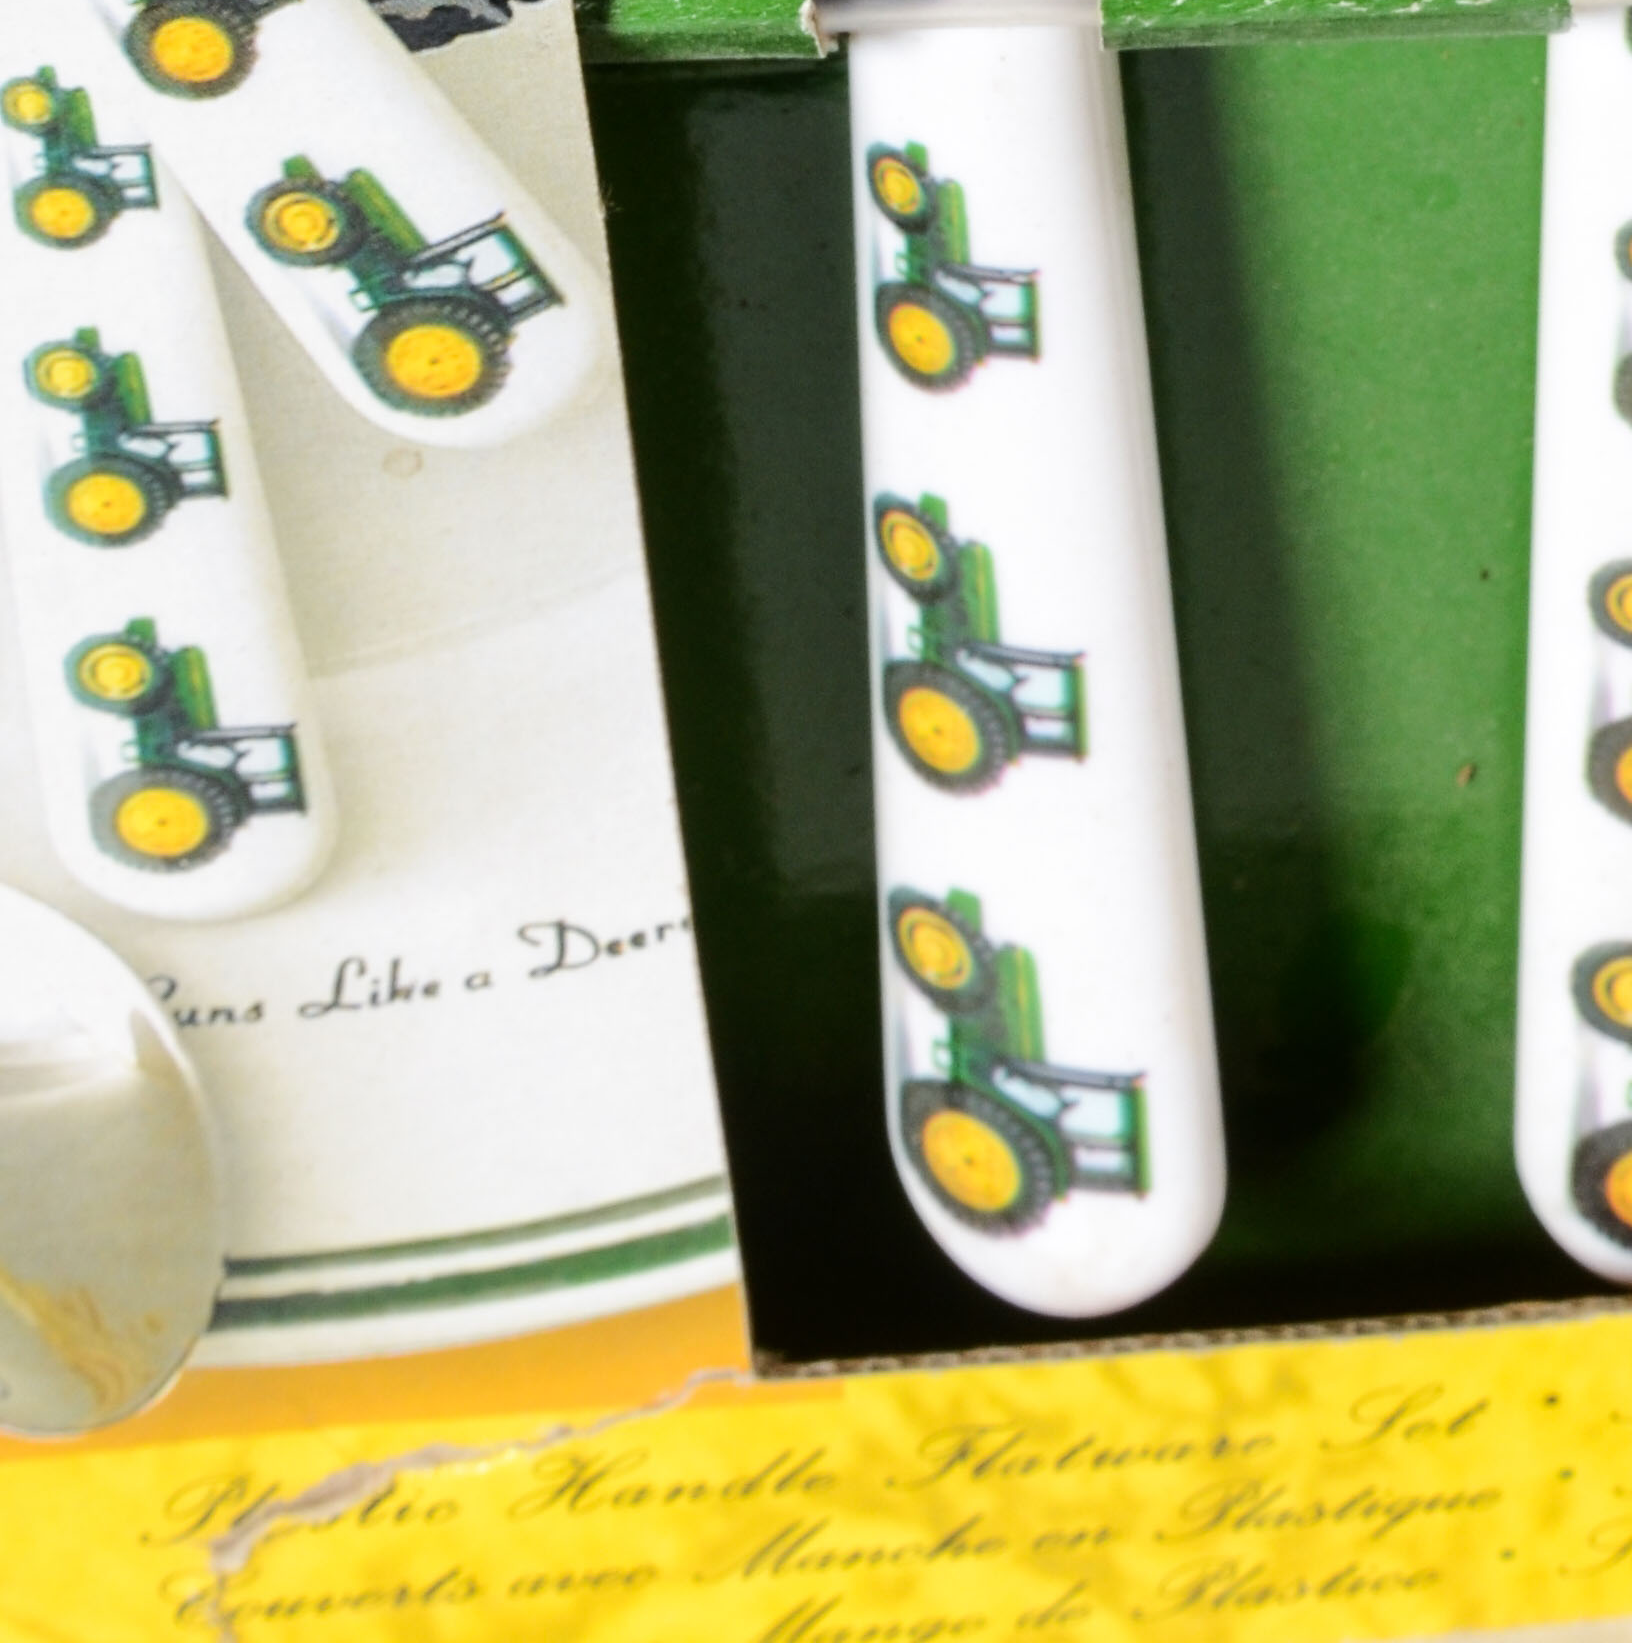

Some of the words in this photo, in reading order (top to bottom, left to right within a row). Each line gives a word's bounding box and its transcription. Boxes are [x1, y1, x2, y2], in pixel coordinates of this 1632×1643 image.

[298, 956, 440, 1018] Like
[463, 970, 494, 990] a
[138, 1470, 459, 1547] Pltic
[508, 1447, 837, 1516] Handle
[885, 1424, 1277, 1491] Flatware
[1320, 1383, 1490, 1454] Set
[690, 1514, 1008, 1585] Manche
[1029, 1520, 1124, 1554] en
[1153, 1475, 1503, 1545] Plastique
[1013, 1577, 1093, 1634] de
